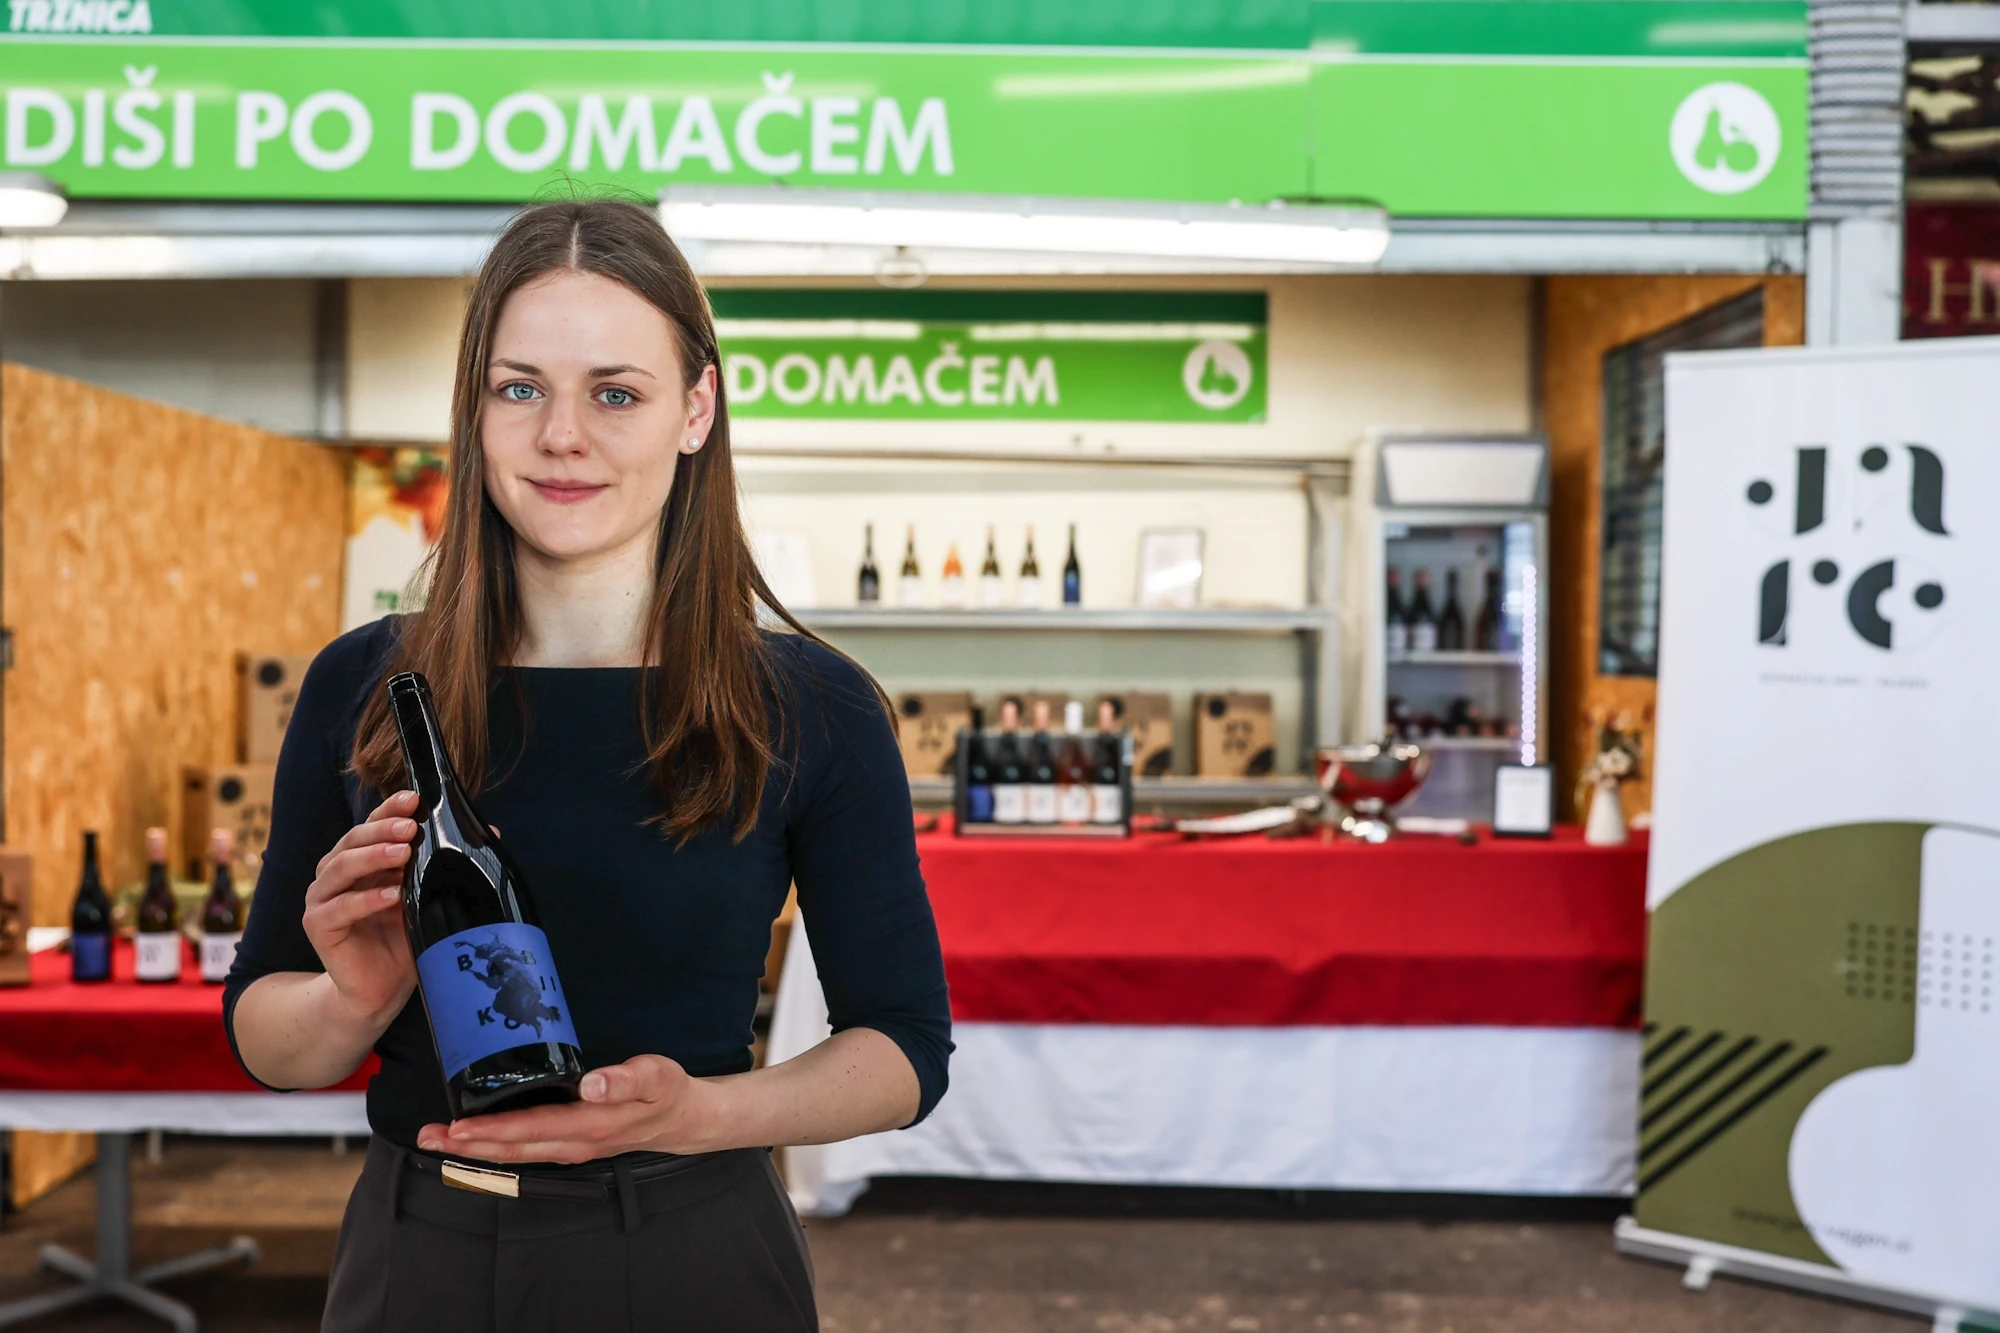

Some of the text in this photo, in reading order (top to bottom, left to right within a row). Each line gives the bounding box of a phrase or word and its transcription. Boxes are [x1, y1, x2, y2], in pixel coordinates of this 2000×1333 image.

[5, 64, 956, 176] DIŠI PO DOMAČEM
[726, 340, 1061, 406] DOMAČEM
